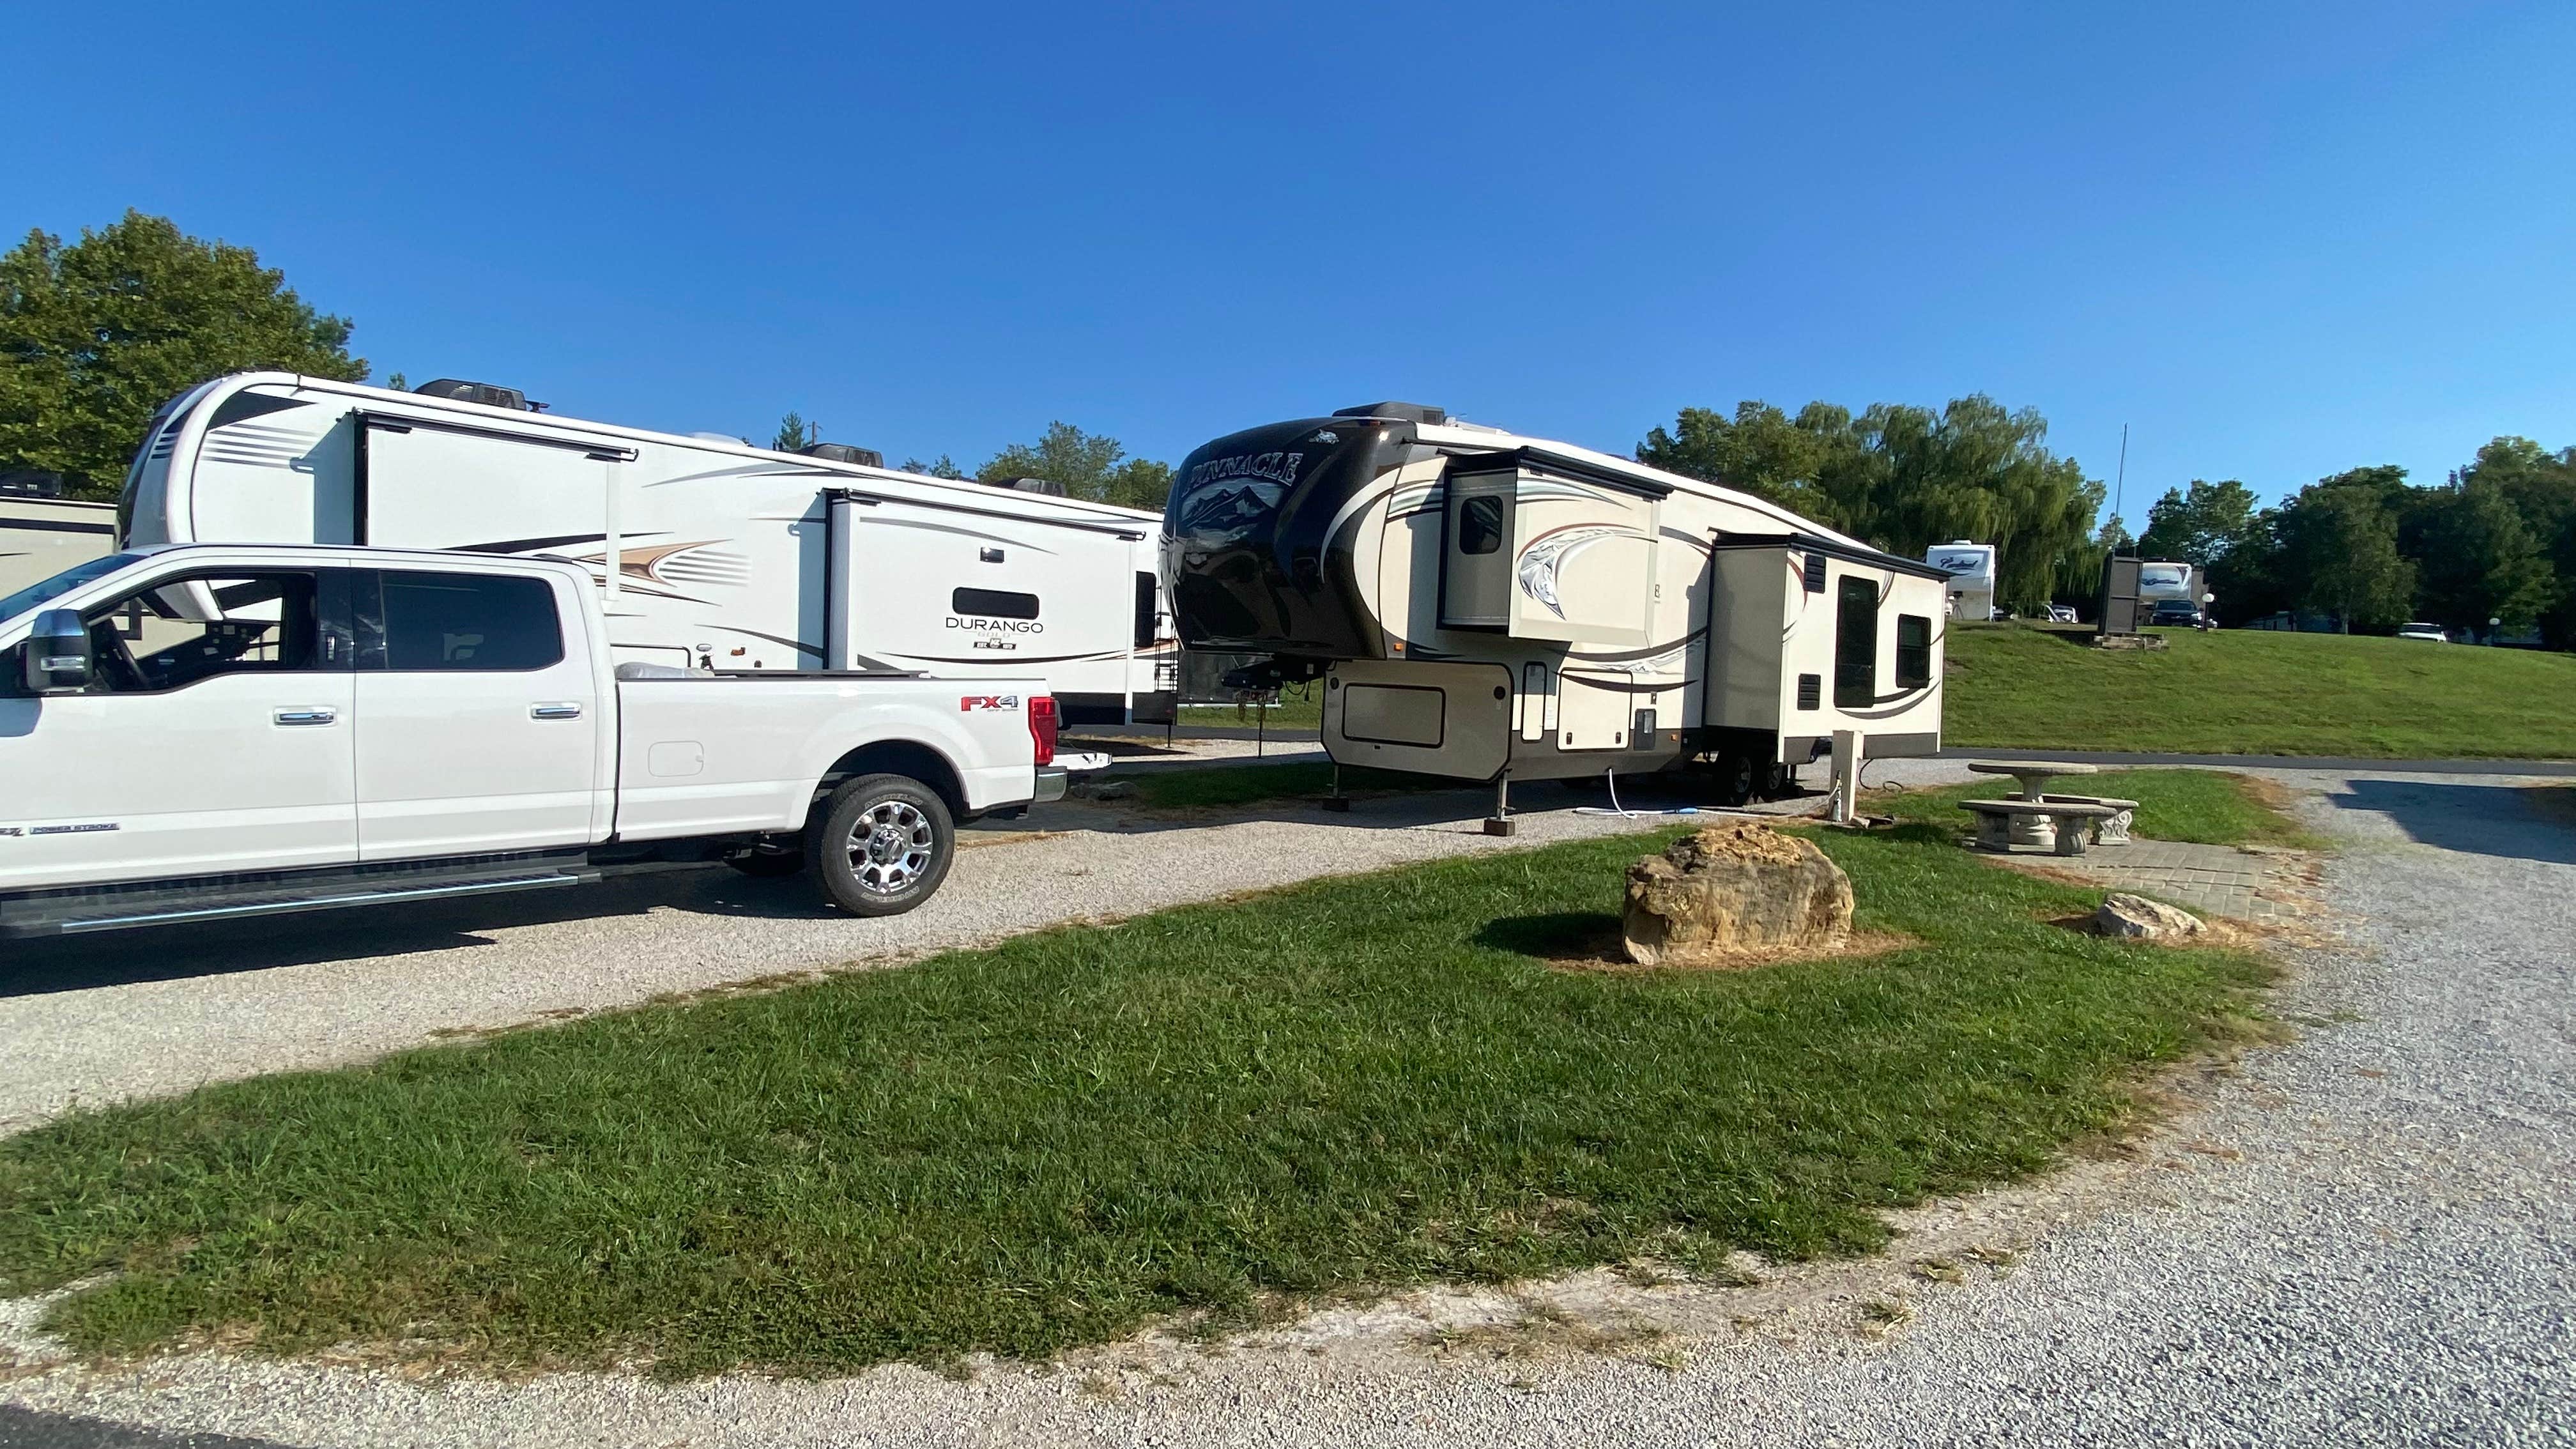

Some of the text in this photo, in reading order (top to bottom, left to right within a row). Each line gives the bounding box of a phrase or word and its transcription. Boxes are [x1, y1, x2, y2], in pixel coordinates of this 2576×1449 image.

[1182, 452, 1303, 497] PINNACLE
[946, 617, 1043, 633] DURANGO
[961, 696, 1018, 711] FX4
[74, 823, 119, 832] STROKE
